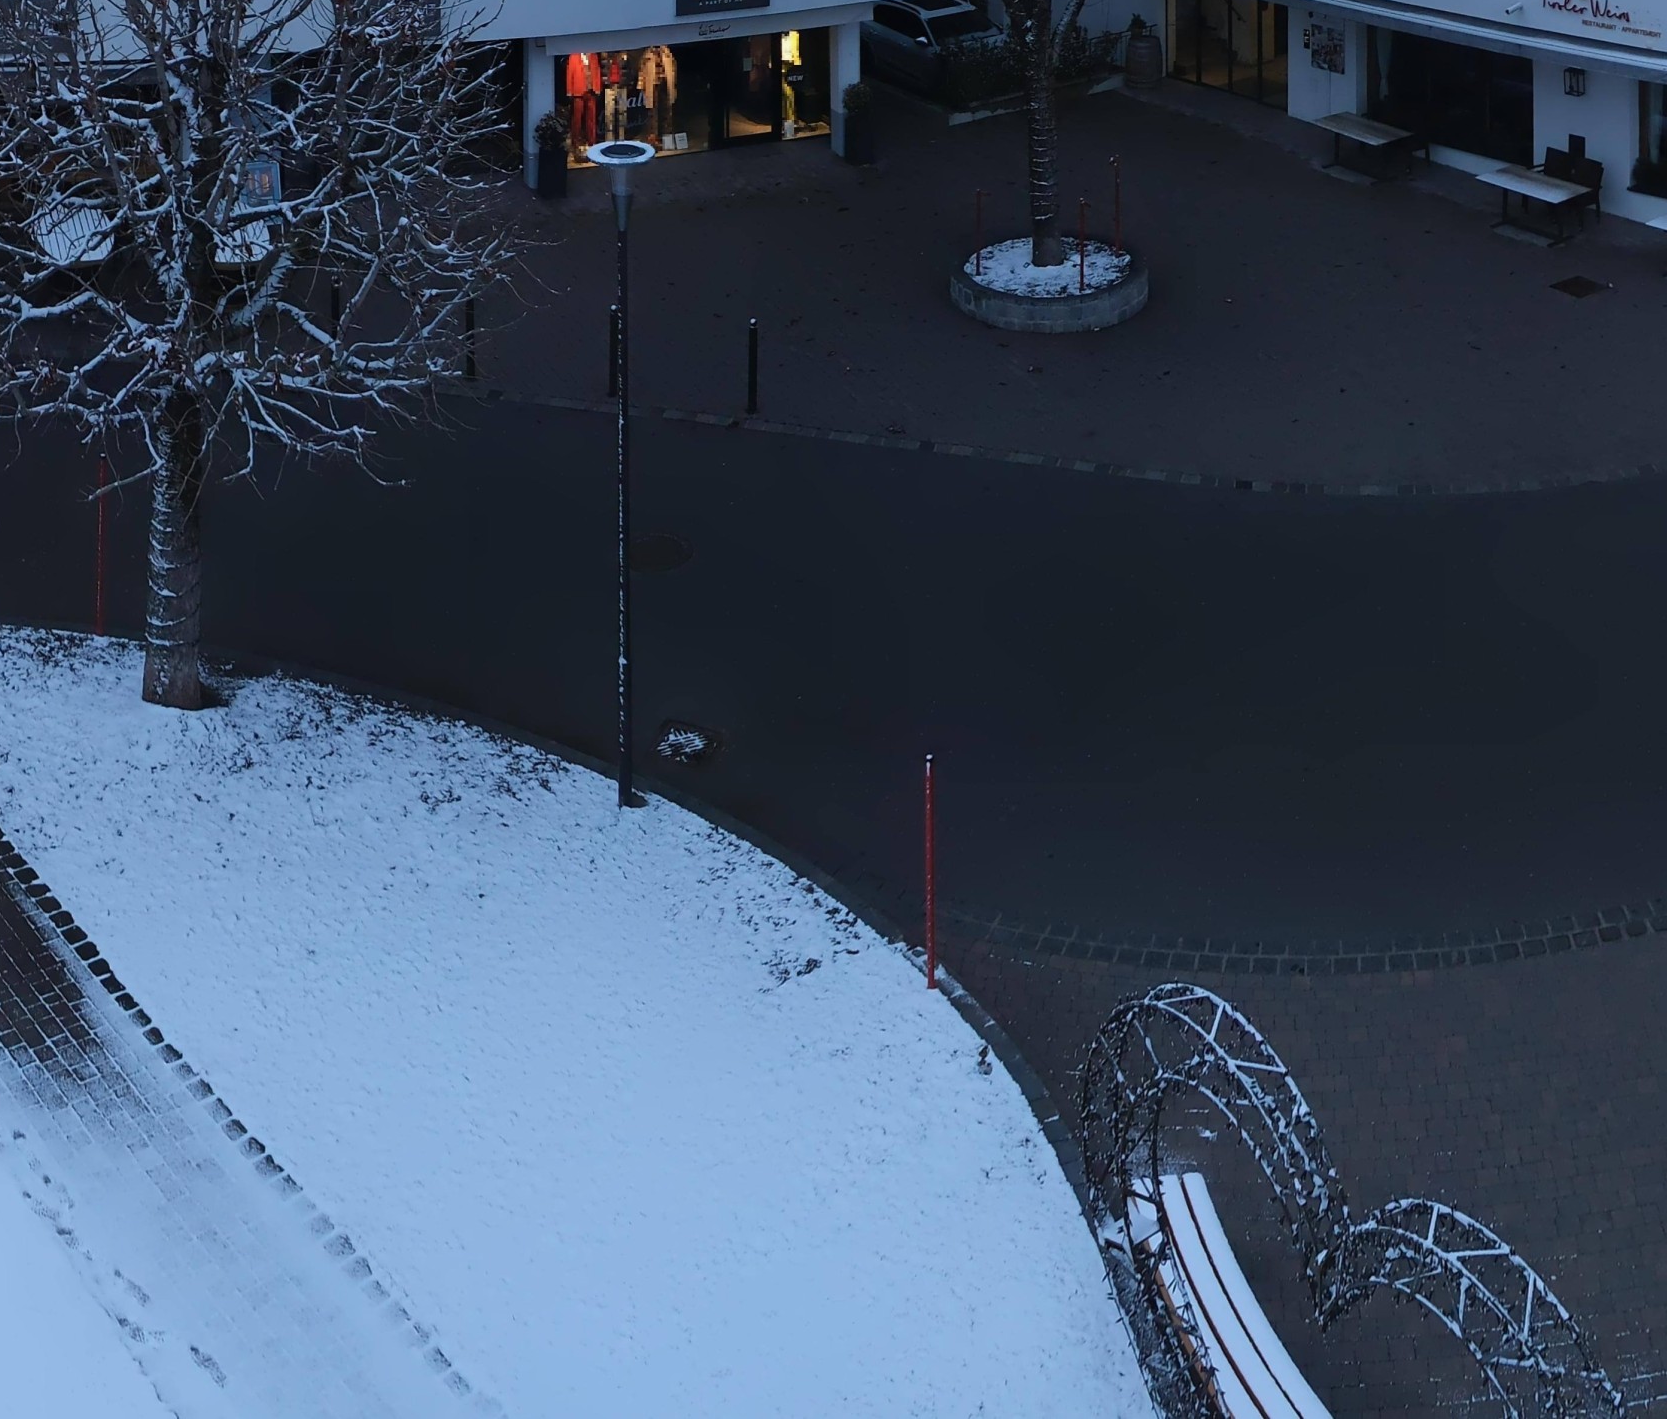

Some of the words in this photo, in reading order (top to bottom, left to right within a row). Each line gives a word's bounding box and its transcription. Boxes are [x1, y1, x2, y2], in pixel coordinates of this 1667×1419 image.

[1581, 19, 1618, 32] RESTAURANT
[1621, 26, 1662, 39] APPARTEMENT
[787, 73, 804, 82] NEW
